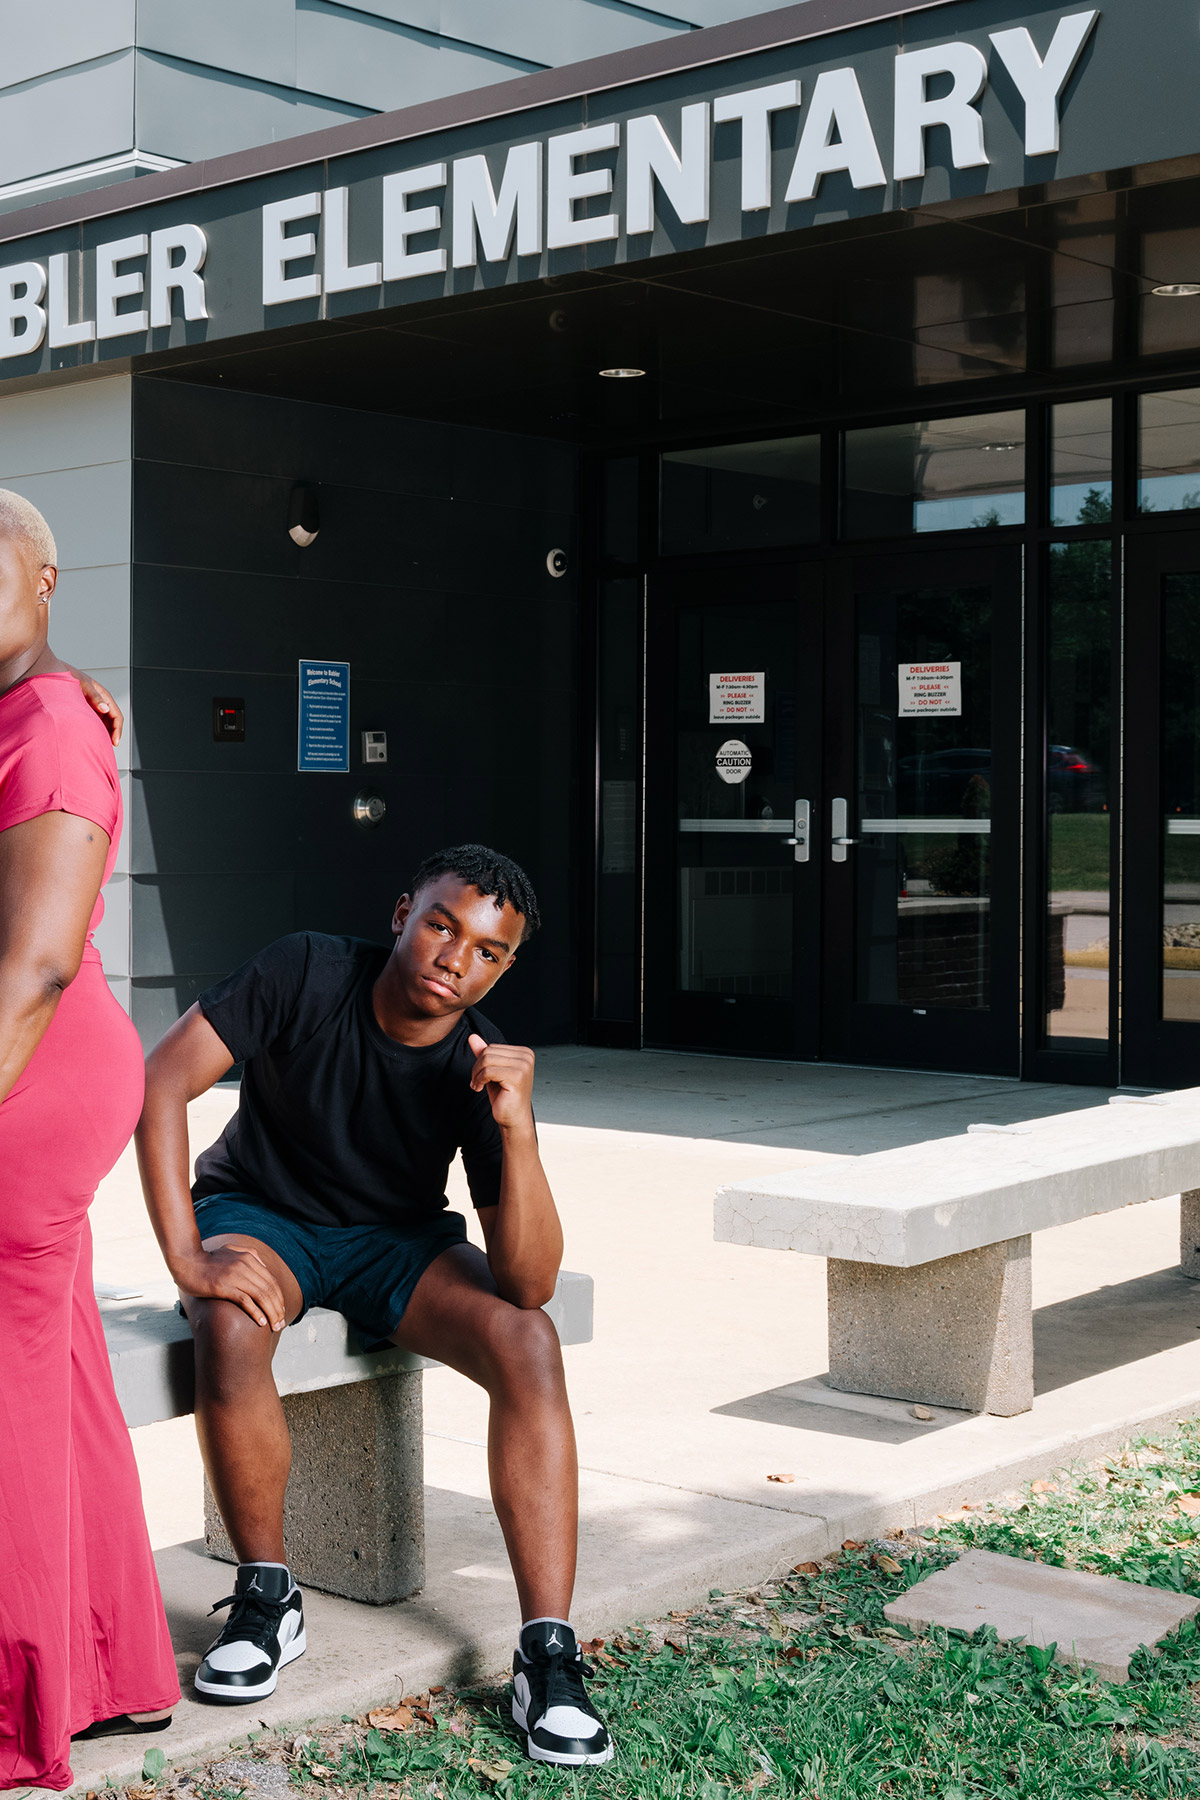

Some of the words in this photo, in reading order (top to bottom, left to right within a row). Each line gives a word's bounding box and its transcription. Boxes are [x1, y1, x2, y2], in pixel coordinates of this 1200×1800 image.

[262, 9, 1100, 305] ELEMENTARY
[910, 665, 950, 673] DELIVERIES
[716, 758, 751, 766] CAUTION
